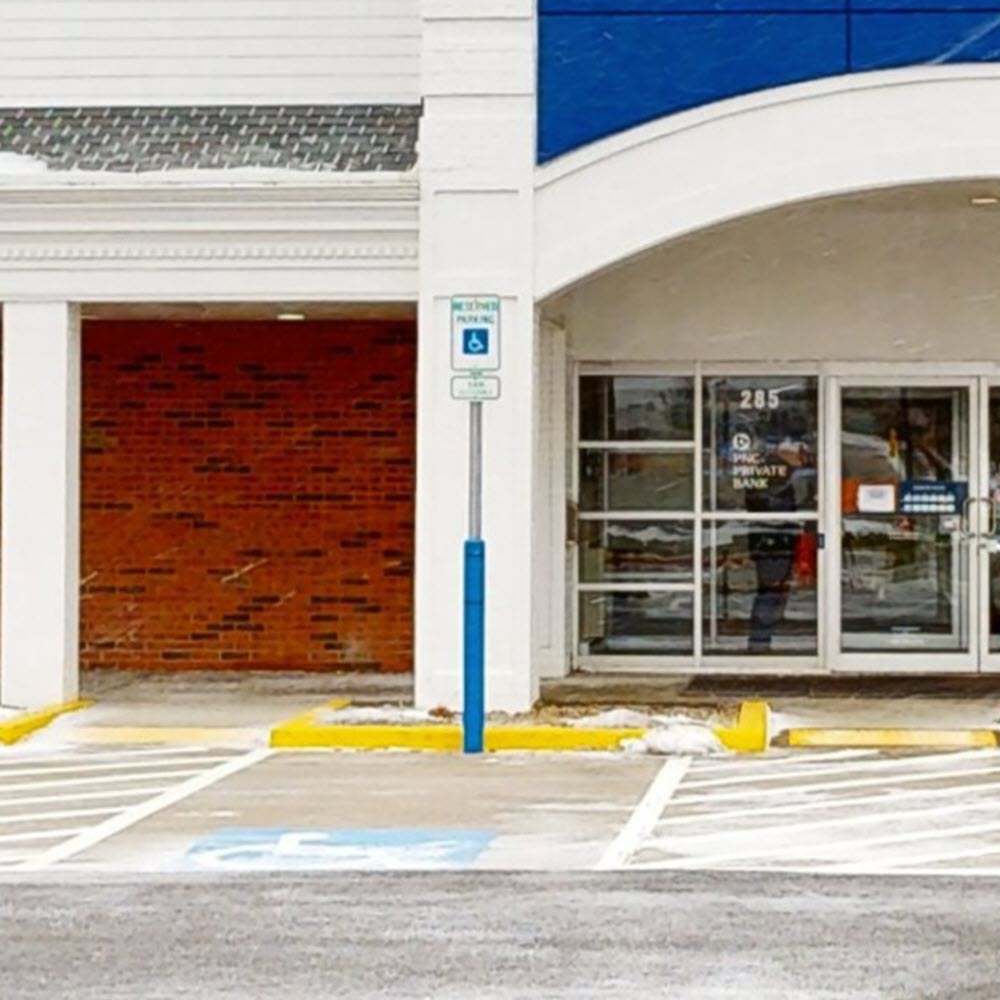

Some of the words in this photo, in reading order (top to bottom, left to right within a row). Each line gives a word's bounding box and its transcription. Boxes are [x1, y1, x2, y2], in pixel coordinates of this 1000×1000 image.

[740, 389, 780, 409] 285
[732, 465, 787, 477] PRIVATE
[732, 478, 769, 489] BANK
